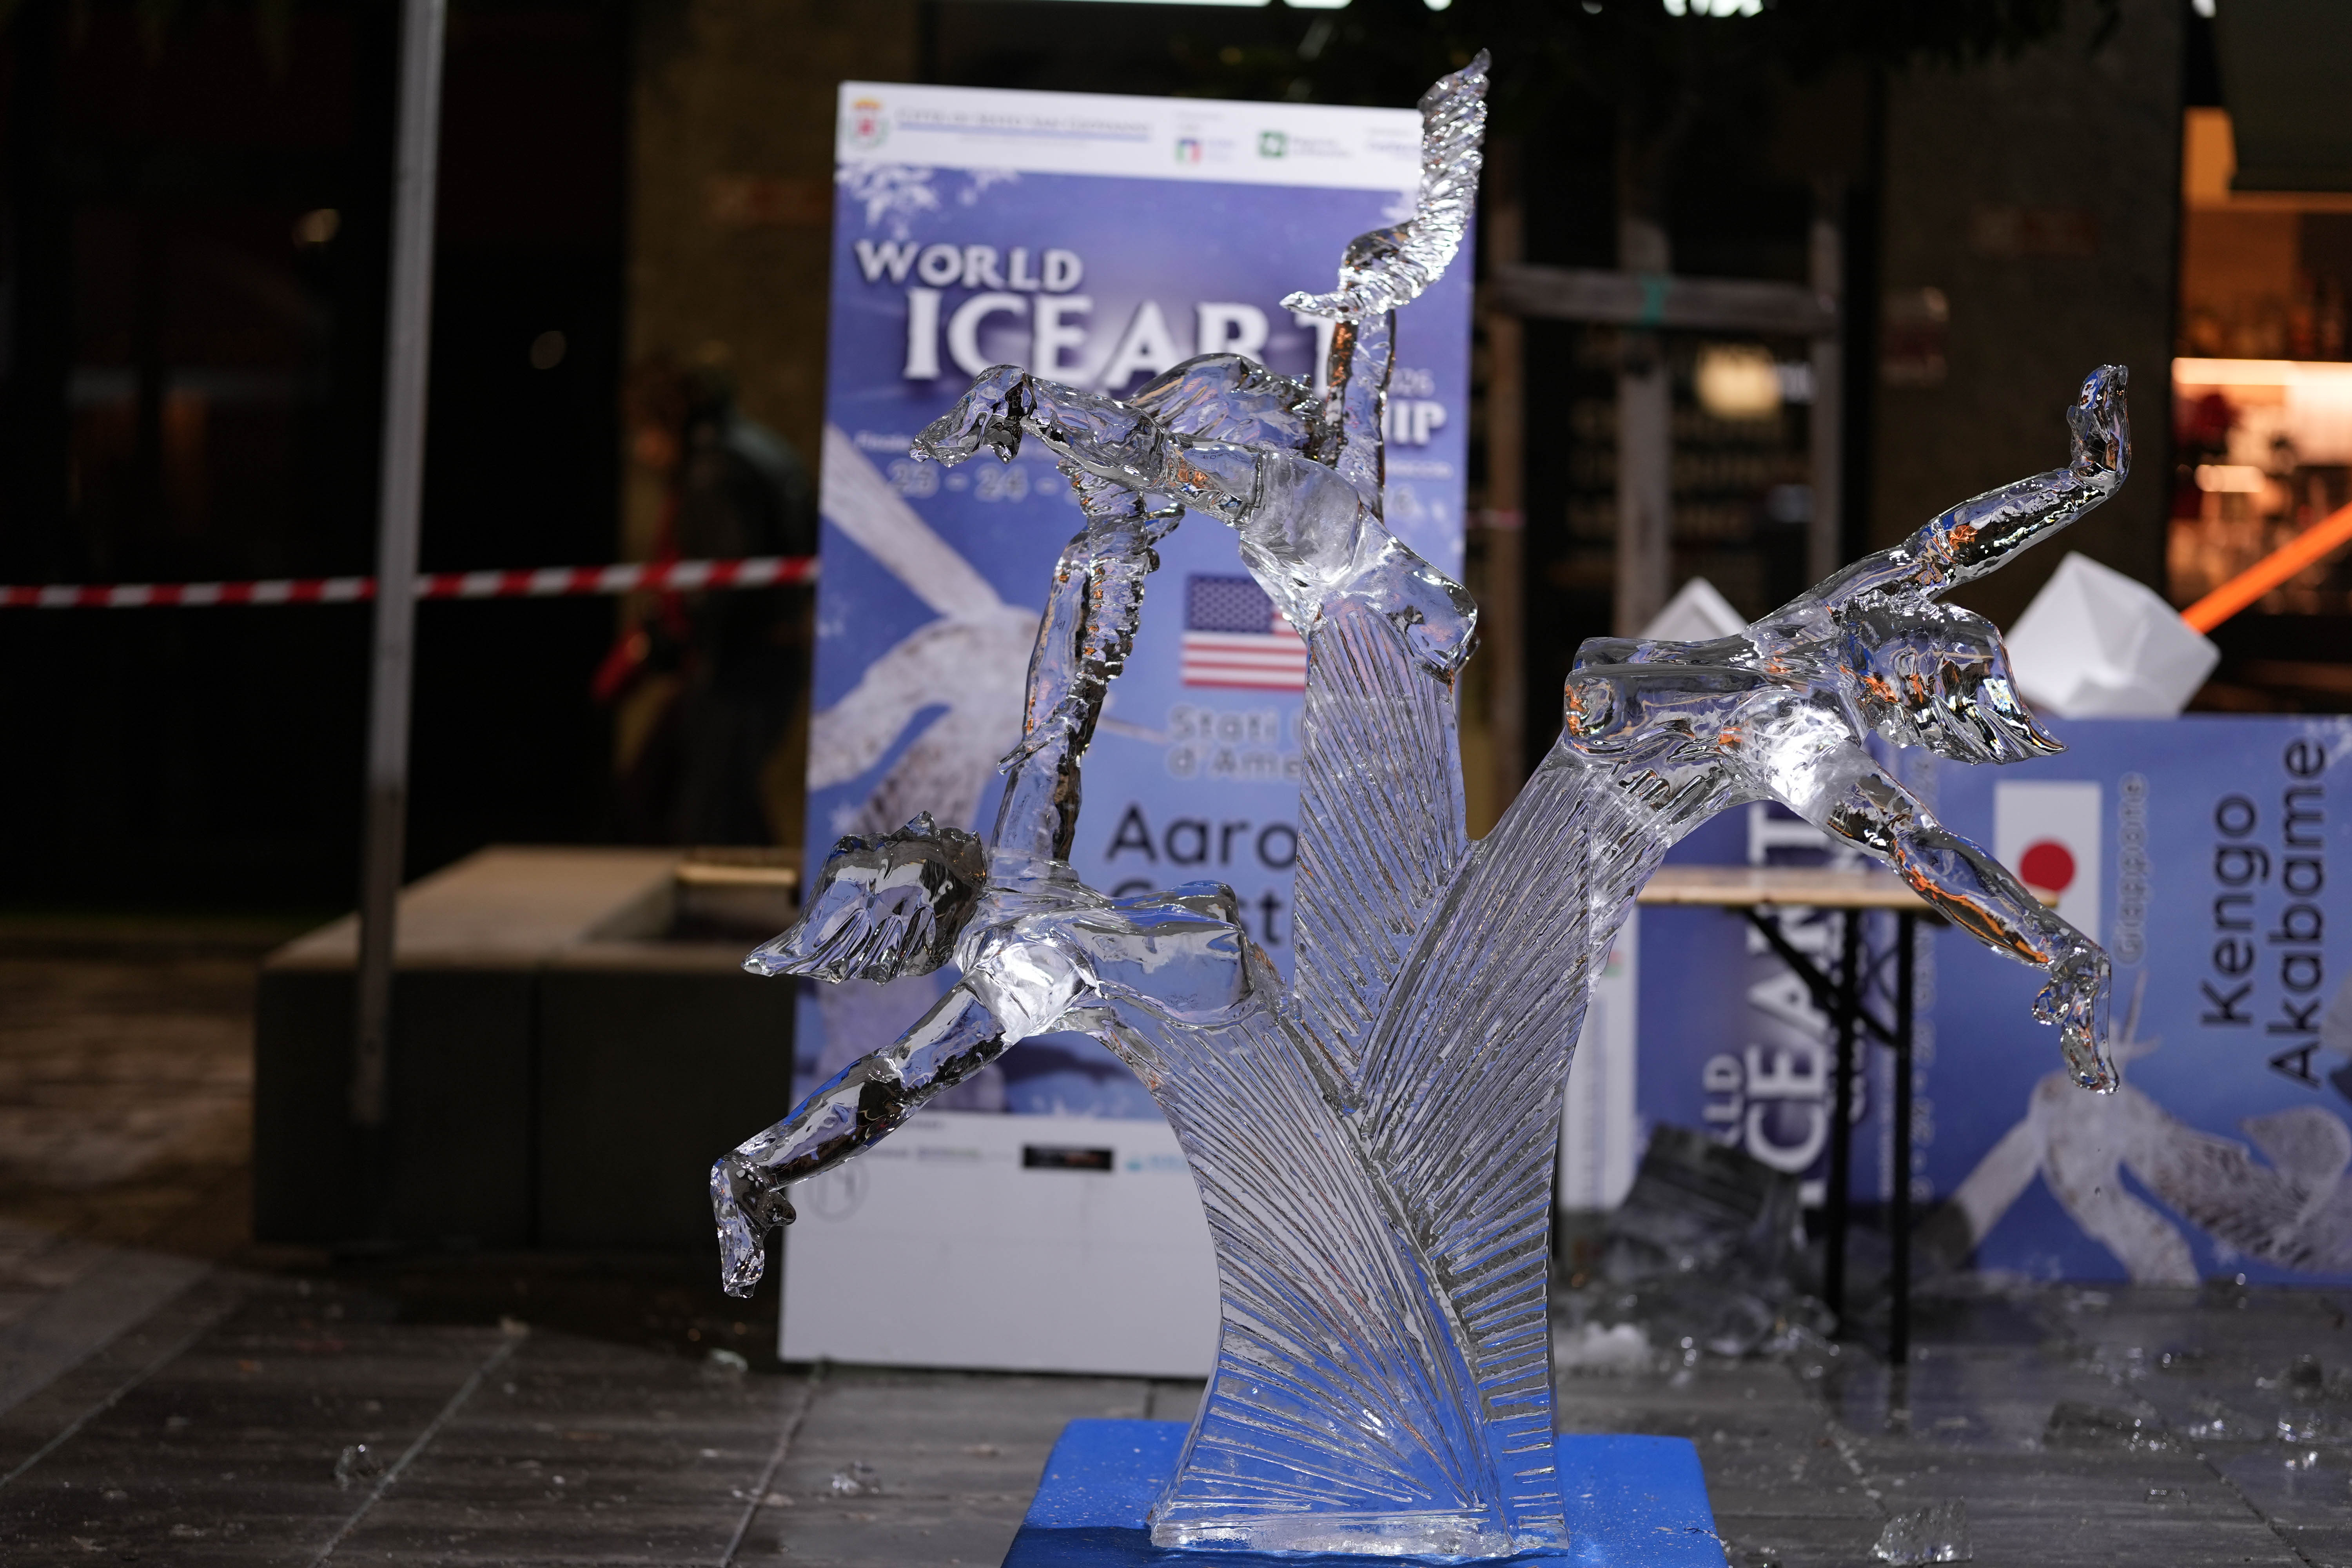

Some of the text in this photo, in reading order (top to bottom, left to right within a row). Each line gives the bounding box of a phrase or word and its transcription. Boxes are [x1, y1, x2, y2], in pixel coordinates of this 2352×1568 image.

[855, 238, 1083, 292] WORLD
[1169, 705, 1279, 743] Stati
[1167, 746, 1302, 780] d'Ame
[1105, 800, 1297, 872] Aaro
[2114, 772, 2151, 964] Giappone
[2200, 793, 2270, 1028] Kengo
[2266, 739, 2325, 1088] Akabame
